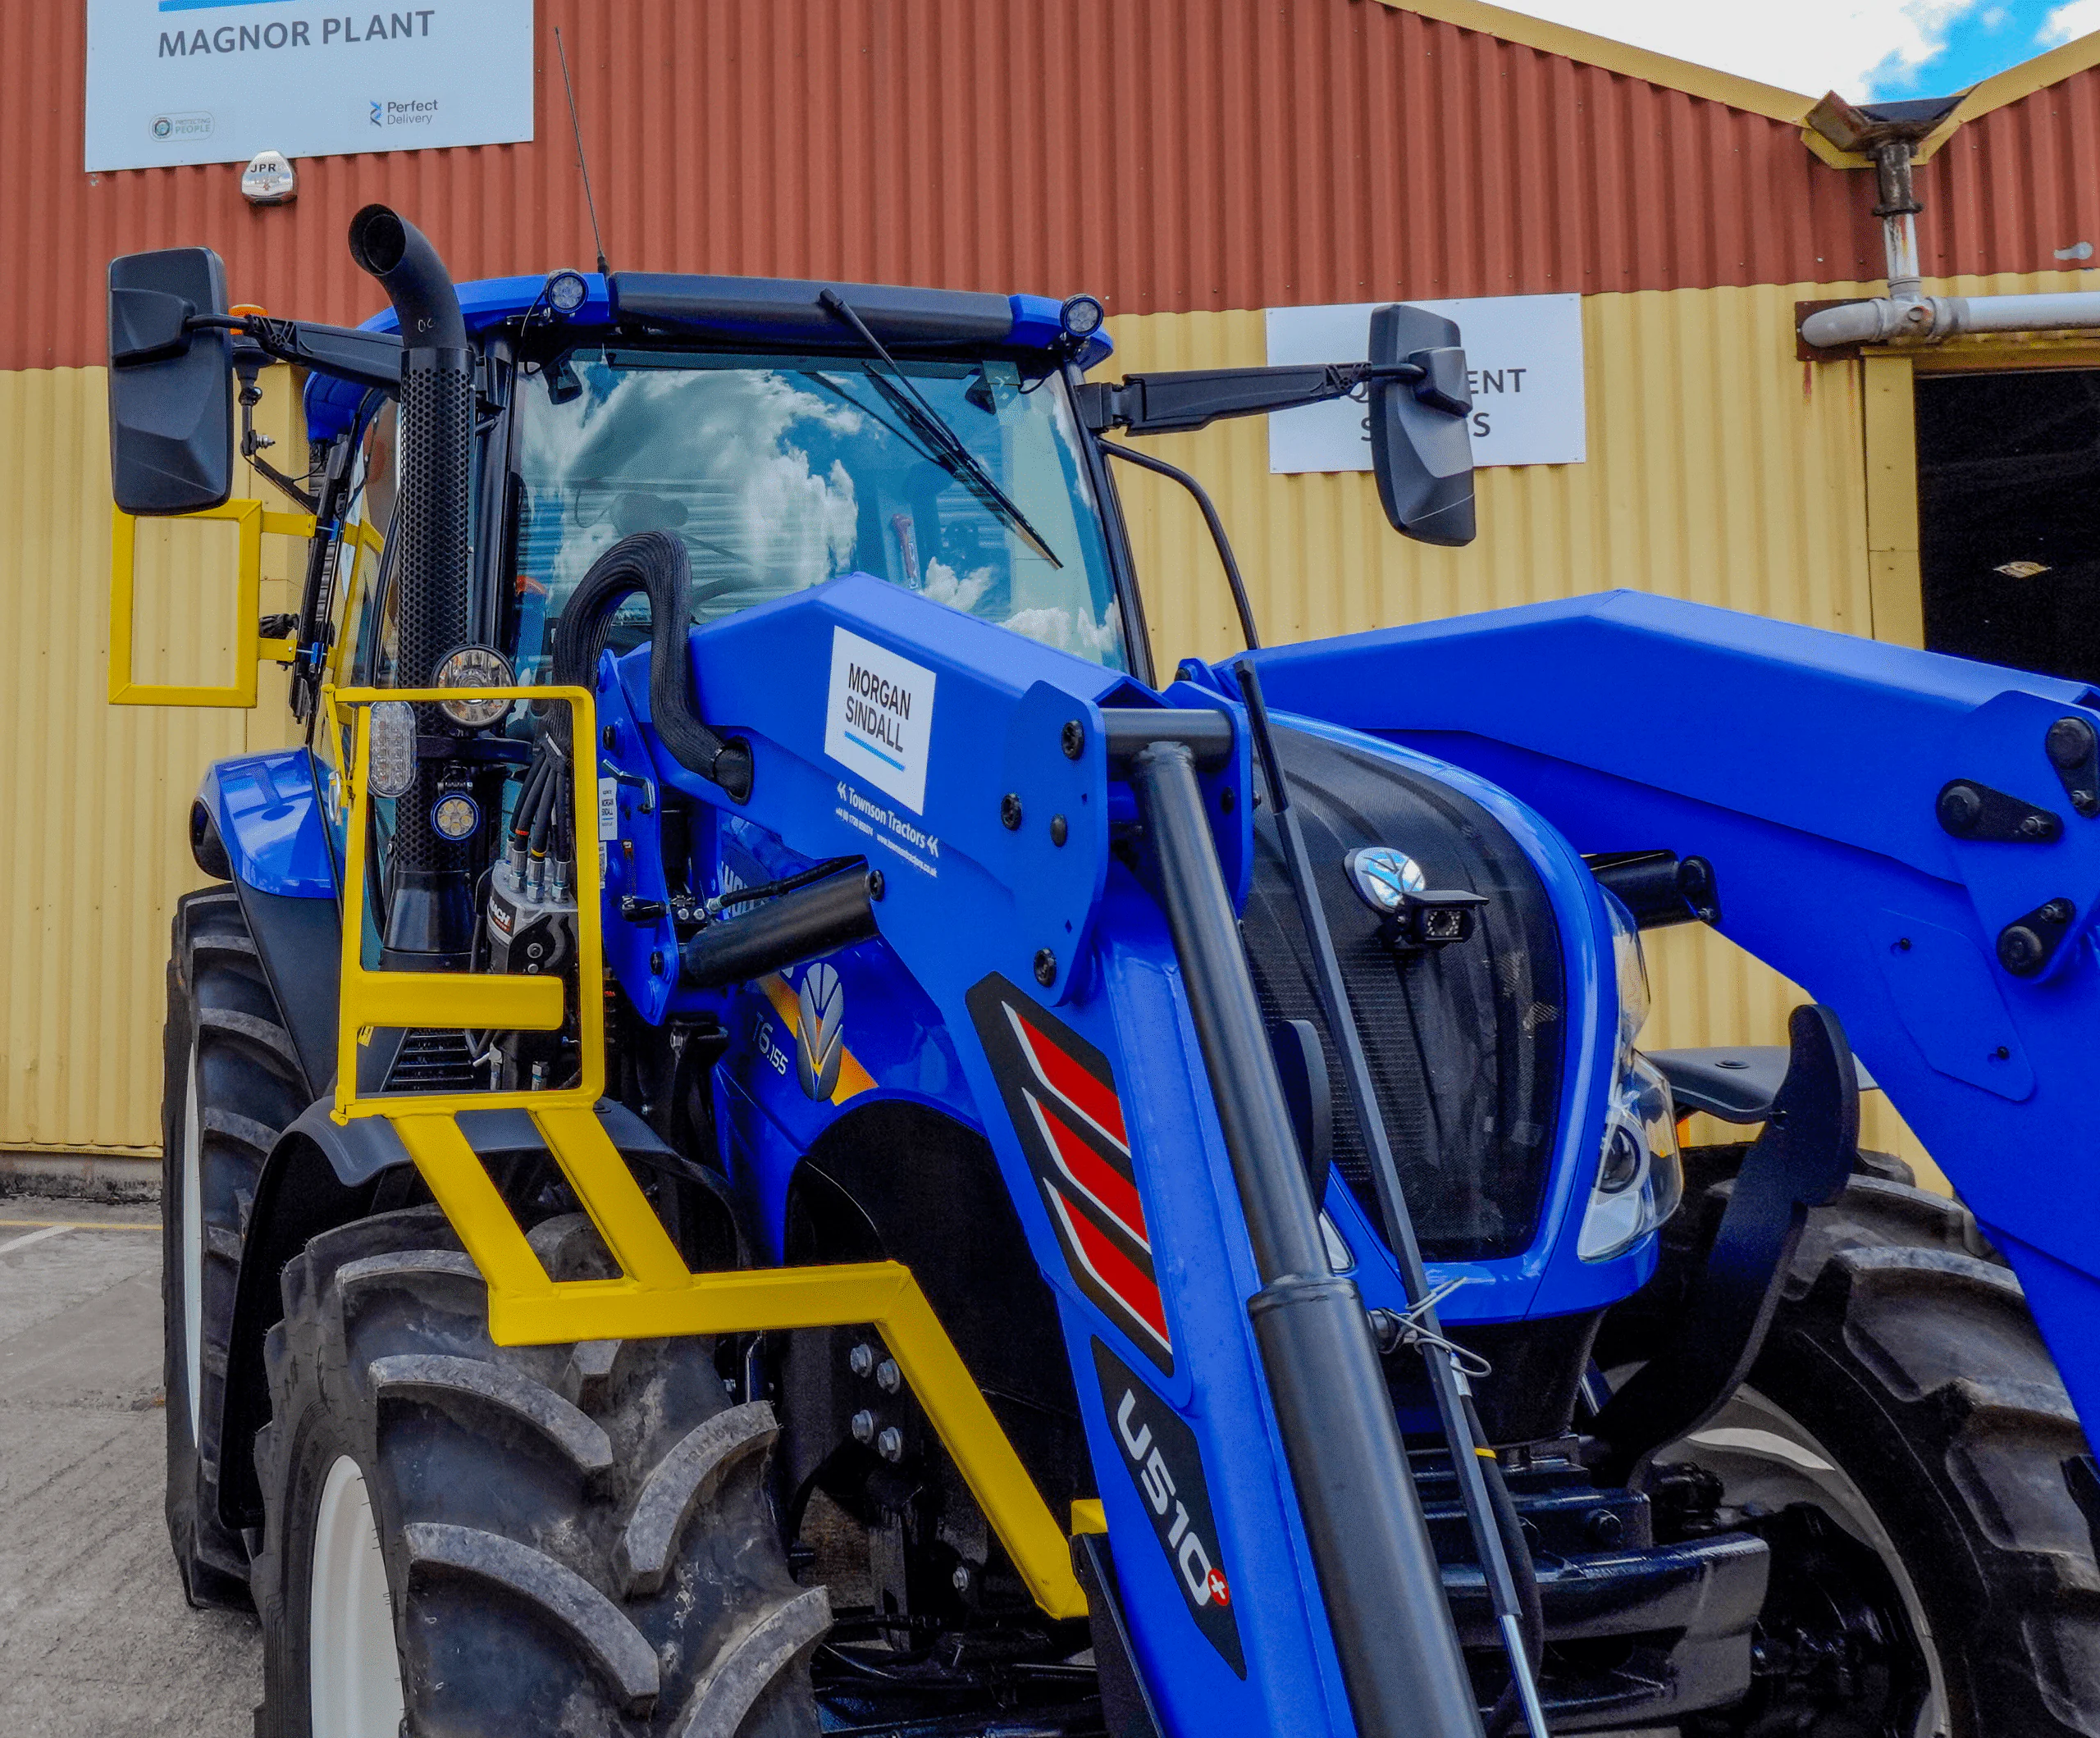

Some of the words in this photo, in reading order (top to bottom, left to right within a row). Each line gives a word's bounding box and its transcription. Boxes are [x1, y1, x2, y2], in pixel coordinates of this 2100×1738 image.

[158, 21, 311, 58] MAGNOR
[322, 10, 436, 44] PLANT
[387, 99, 439, 113] Perfect
[387, 113, 432, 125] Delivery
[175, 124, 211, 134] PEOPLE
[250, 163, 276, 173] JPR
[848, 663, 911, 720] MORGAN
[845, 695, 904, 753] SINDALL
[848, 787, 887, 825] Townson
[888, 810, 926, 849] Tractors
